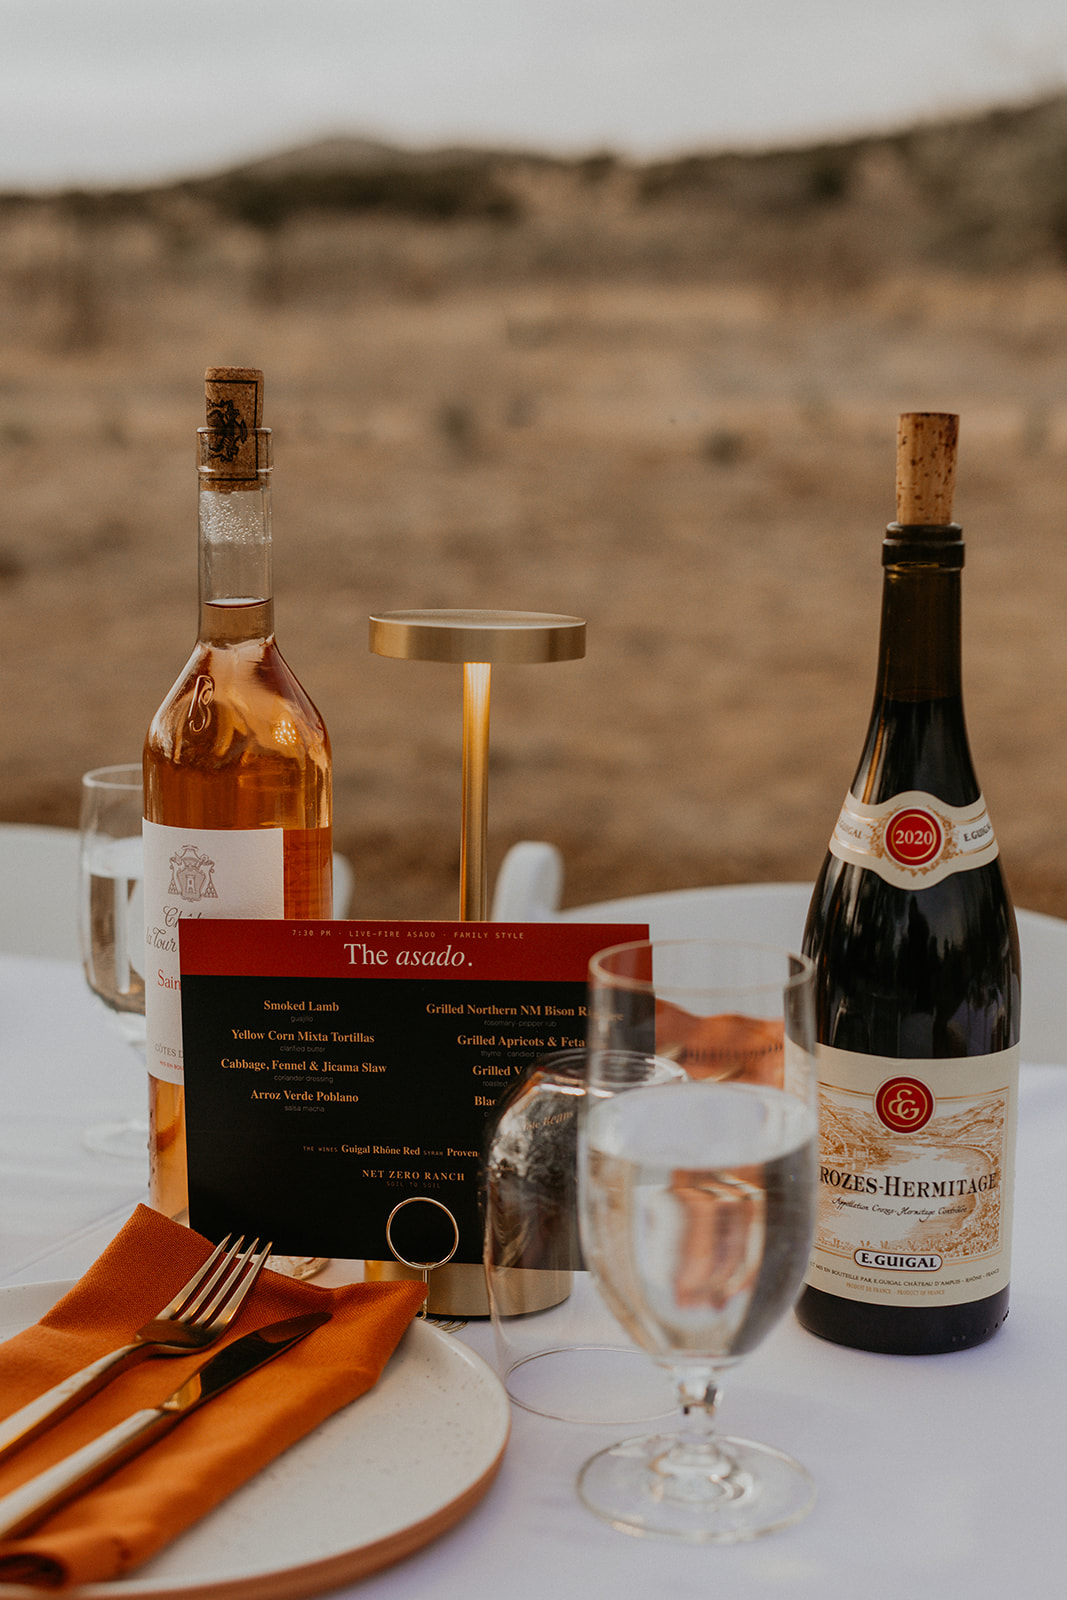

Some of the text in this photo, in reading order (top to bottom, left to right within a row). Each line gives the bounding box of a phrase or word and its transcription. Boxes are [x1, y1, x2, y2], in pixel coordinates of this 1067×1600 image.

[895, 830, 934, 846] 2020
[153, 927, 178, 952] Tour
[320, 930, 332, 938] PM
[495, 932, 525, 940] STYLE
[343, 943, 474, 967] The asado.
[157, 968, 182, 991] Sain
[264, 1000, 340, 1012] Smoked Lamb
[426, 1003, 464, 1015] Grilled
[467, 1003, 518, 1016] Northern
[520, 1005, 541, 1016] NM
[544, 1005, 576, 1017] Bison
[231, 1029, 375, 1043] Yellow Corn Mixta Tortillas
[457, 1034, 586, 1048] Grilled Apricots & Feta
[220, 1058, 388, 1073] Cabbage, Fennel & Jicama Slaw
[472, 1065, 511, 1076] Grilled
[250, 1089, 359, 1103] Arroz Verde Poblano
[341, 1144, 371, 1155] Guigal
[372, 1144, 401, 1155] Rhône
[403, 1146, 421, 1156] Red
[446, 1147, 480, 1158] Proven
[362, 1169, 466, 1182] NET ZERO RANCH
[819, 1165, 997, 1198] ROZES-HERMITAGE
[861, 1252, 937, 1269] E.GUIGAL
[831, 1268, 859, 1281] BOUTEILLE
[860, 1276, 873, 1284] PAR
